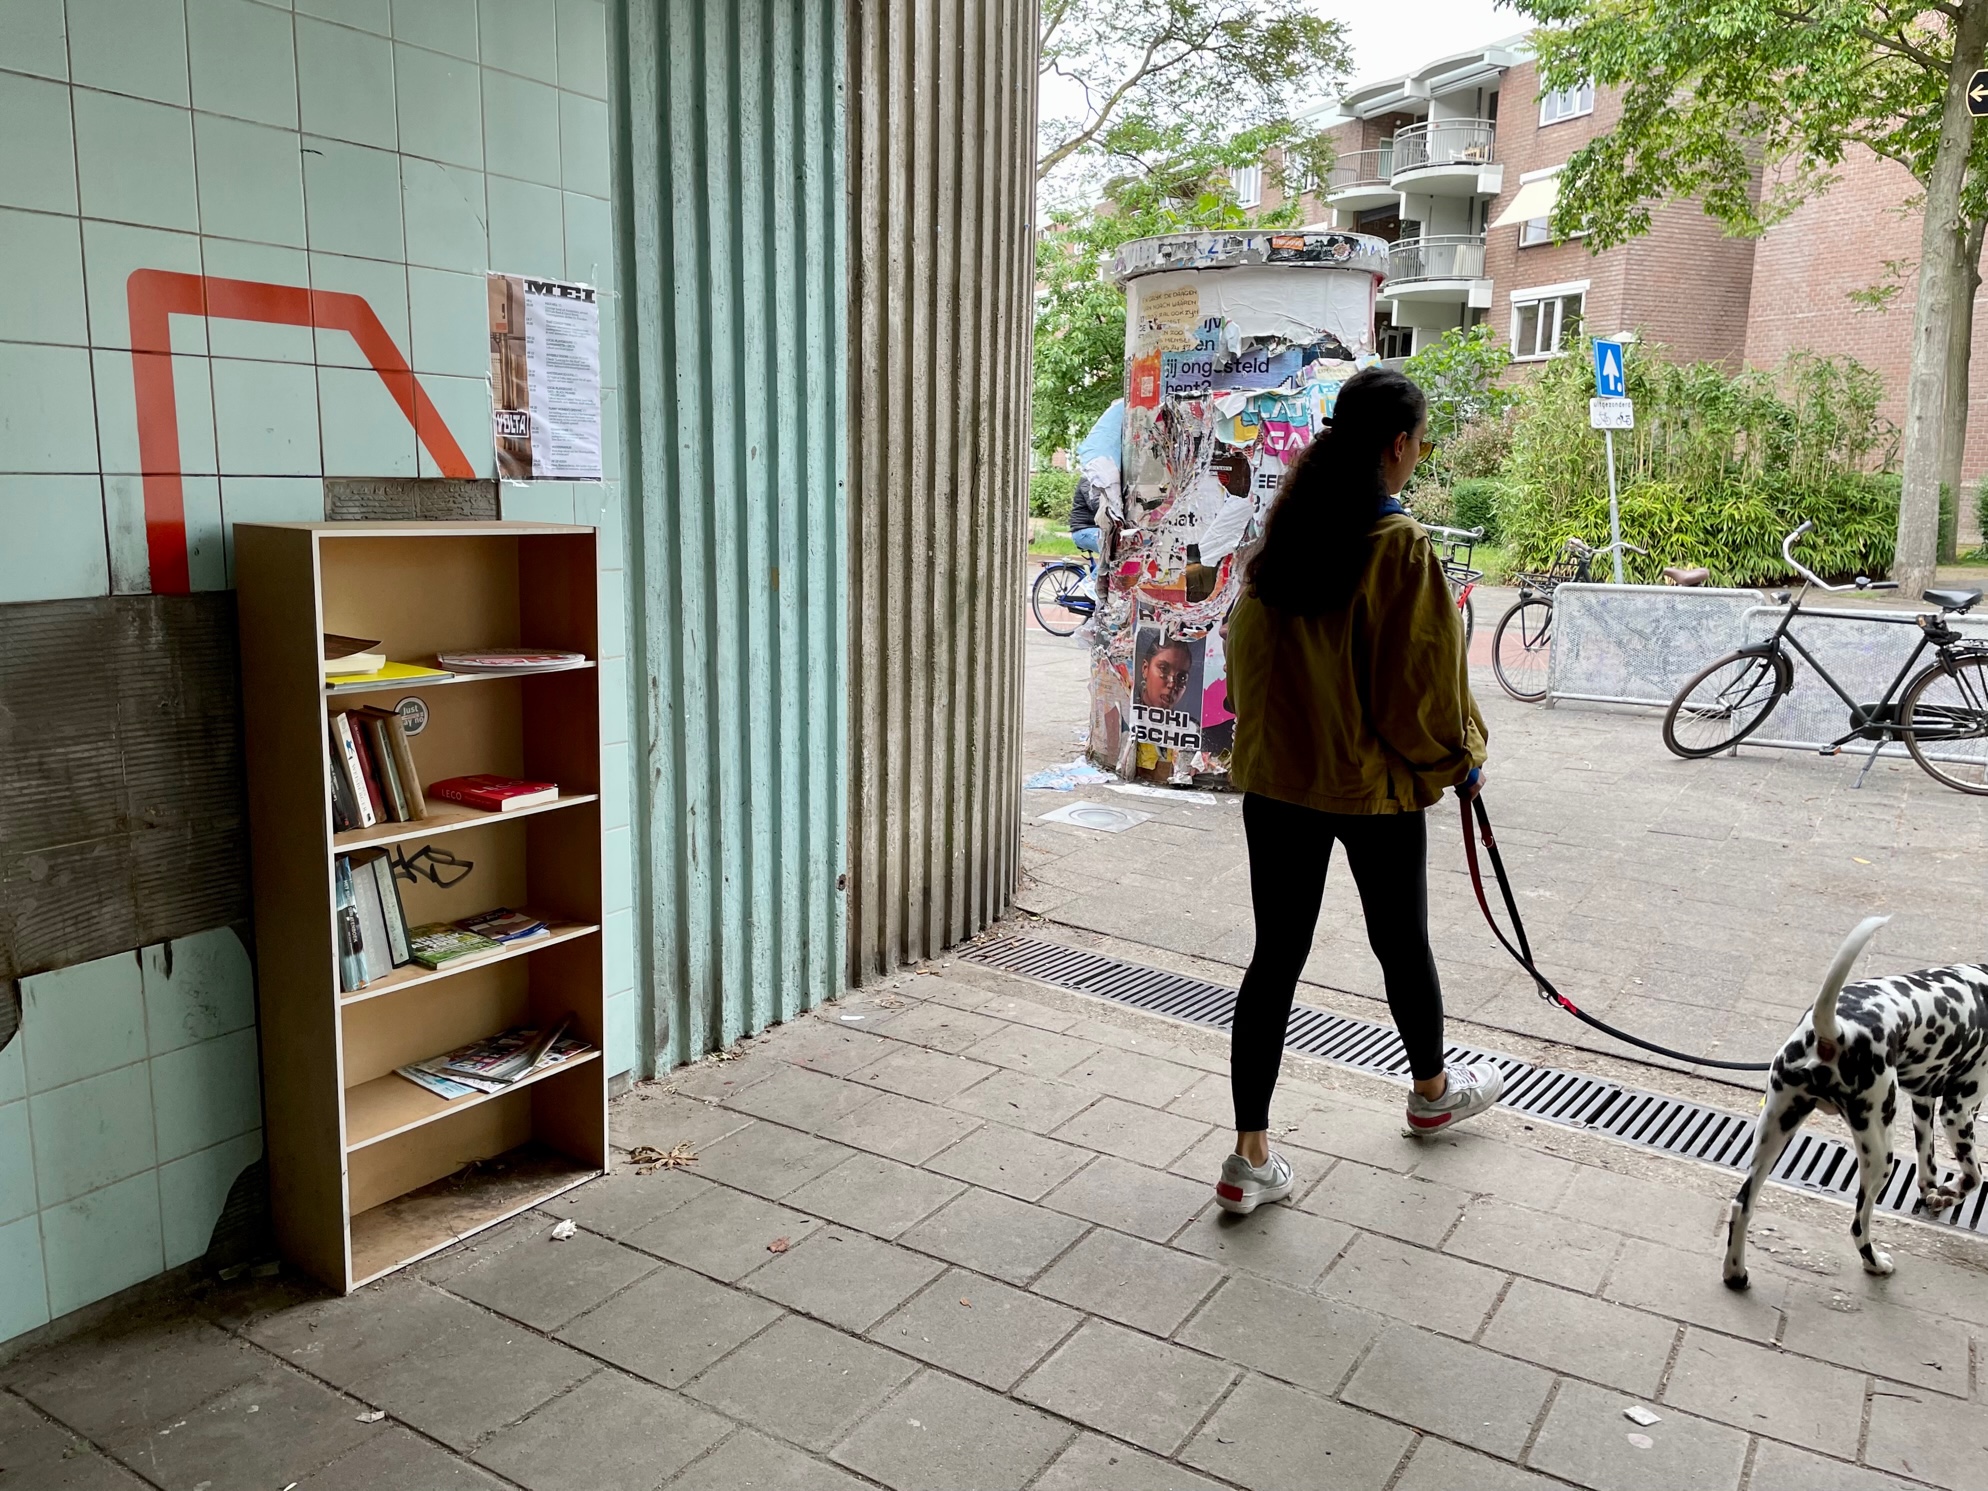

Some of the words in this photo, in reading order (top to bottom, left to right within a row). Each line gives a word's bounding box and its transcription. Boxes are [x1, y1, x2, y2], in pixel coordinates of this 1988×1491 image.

[524, 280, 595, 304] MEI
[1181, 358, 1270, 378] ongsteld
[497, 413, 527, 434] VOLTA
[403, 704, 419, 716] Just
[414, 716, 424, 724] no
[1133, 706, 1188, 728] TOKI
[1131, 725, 1200, 748] SCHA
[441, 788, 462, 800] LECO
